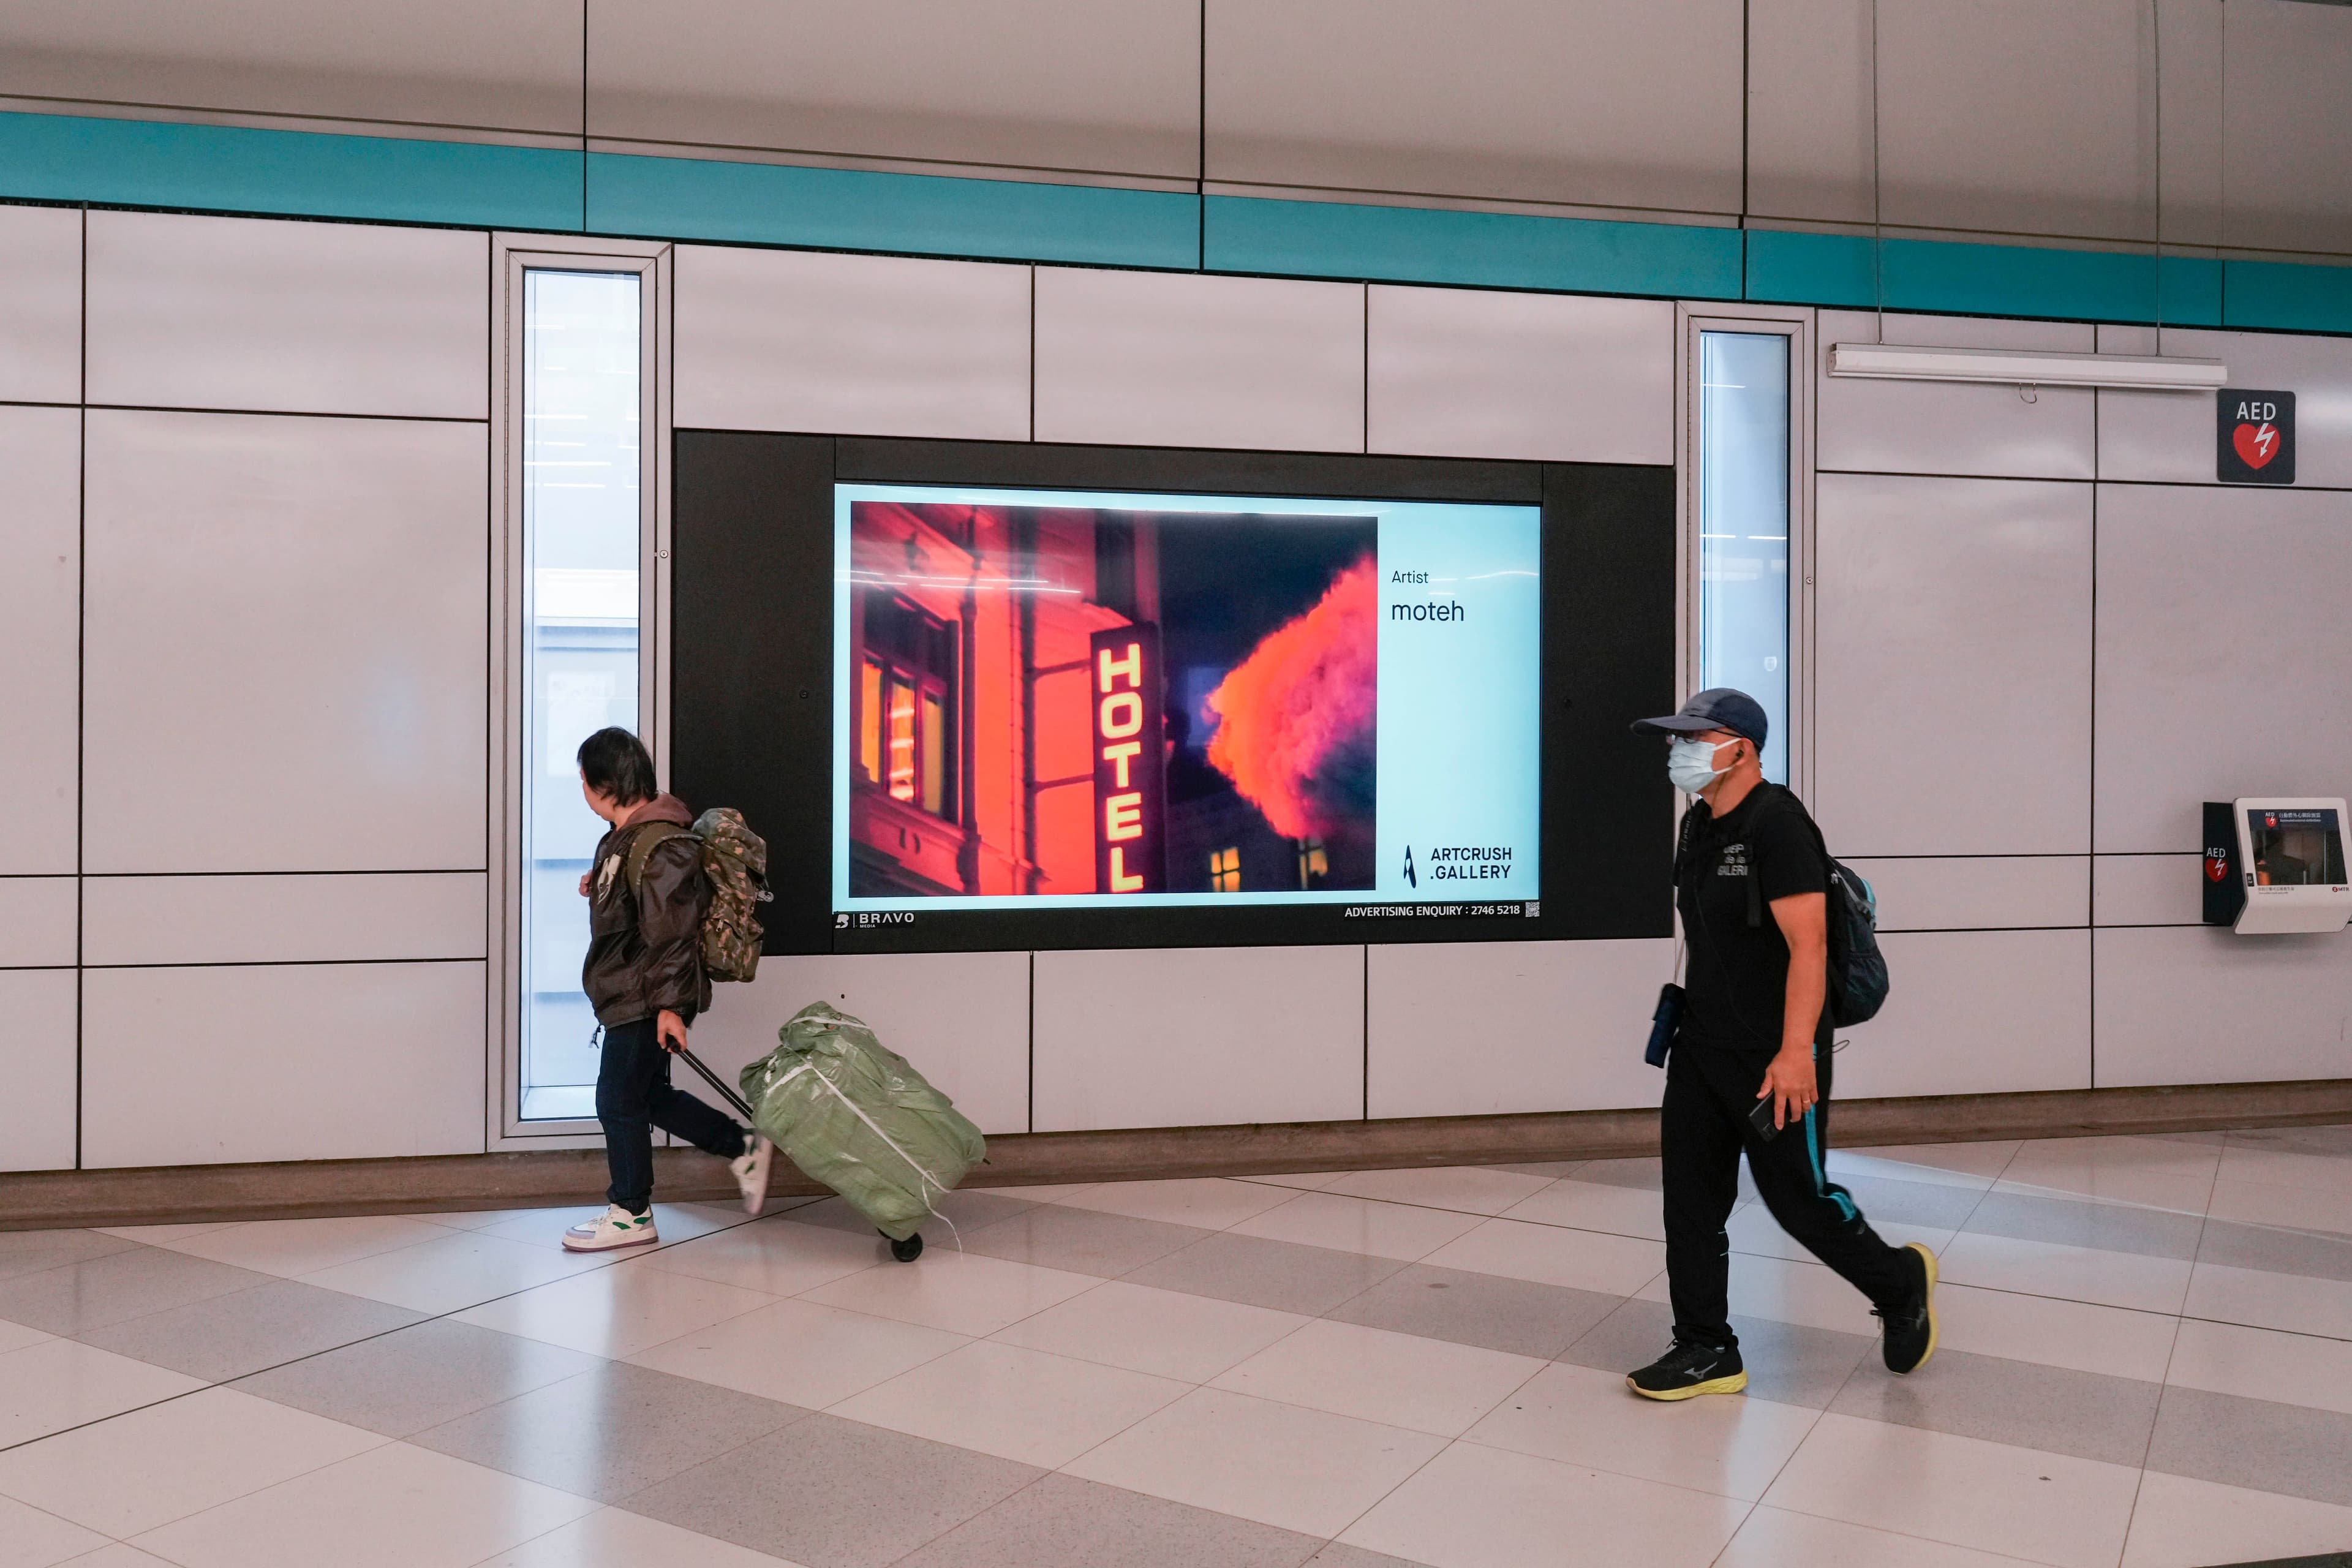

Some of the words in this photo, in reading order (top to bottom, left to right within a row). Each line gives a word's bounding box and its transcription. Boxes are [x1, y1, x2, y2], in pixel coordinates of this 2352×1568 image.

[2236, 401, 2276, 421] AED
[1392, 570, 1429, 584] Artist
[1392, 600, 1464, 621] moteh
[1098, 643, 1144, 892] HOTEL
[1431, 847, 1512, 861] ARTCRUSH
[2206, 847, 2226, 858] AED
[1430, 864, 1512, 880] .GALLERY
[859, 913, 914, 924] BRAVO
[1344, 907, 1414, 918] ADVERTISING
[1417, 906, 1462, 918] ENQUIRY
[1471, 905, 1494, 916] 2746
[1497, 905, 1520, 915] 5218
